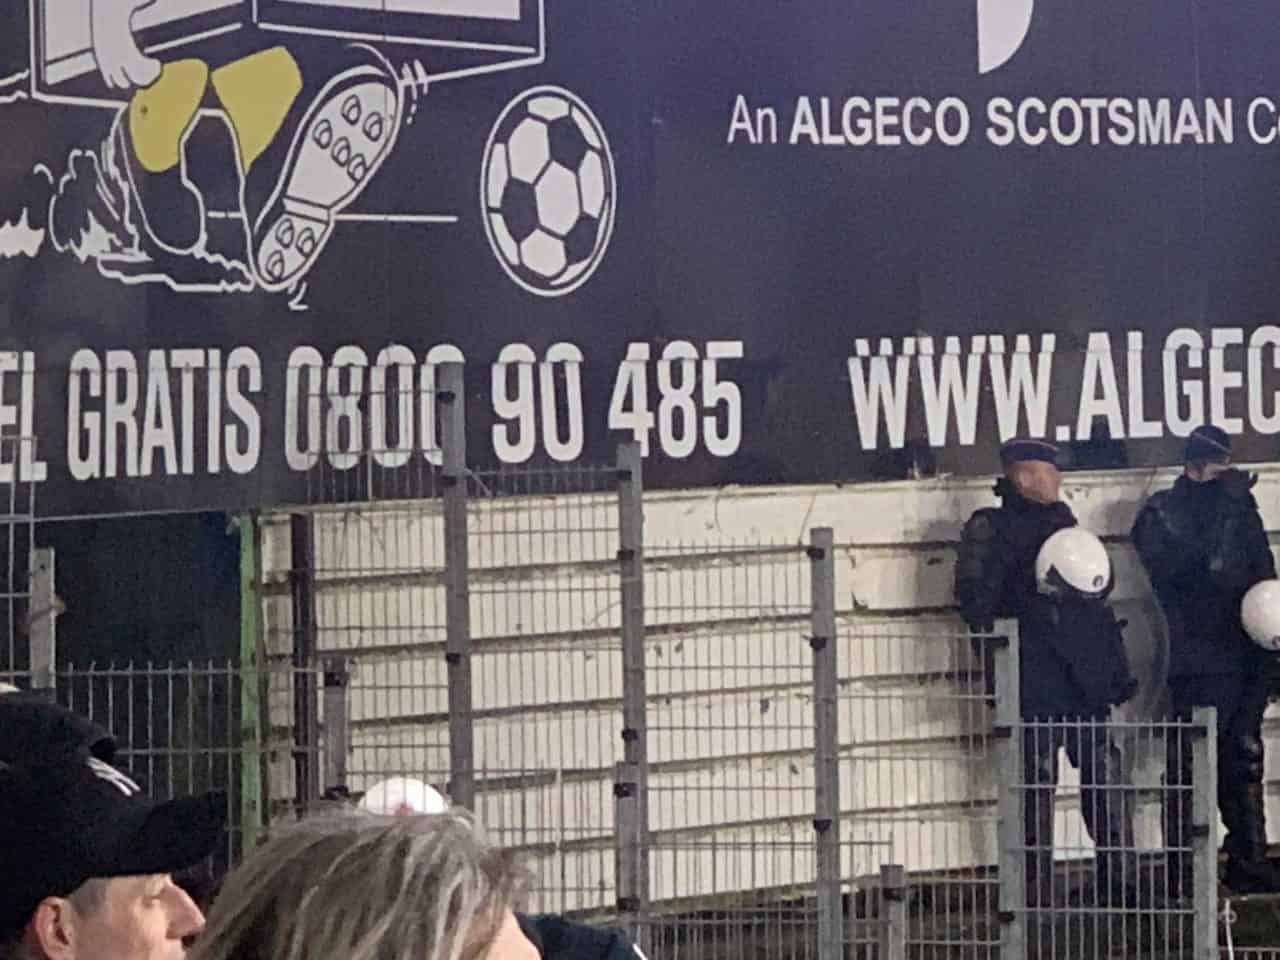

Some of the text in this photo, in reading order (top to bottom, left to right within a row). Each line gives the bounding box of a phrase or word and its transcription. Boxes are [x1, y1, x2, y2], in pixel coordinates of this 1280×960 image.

[727, 94, 777, 144] An
[789, 95, 970, 146] ALGECO
[986, 96, 1233, 146] SCOTSMAN
[67, 346, 262, 481] GRATIS
[492, 343, 585, 463] 90
[608, 340, 744, 460] 485
